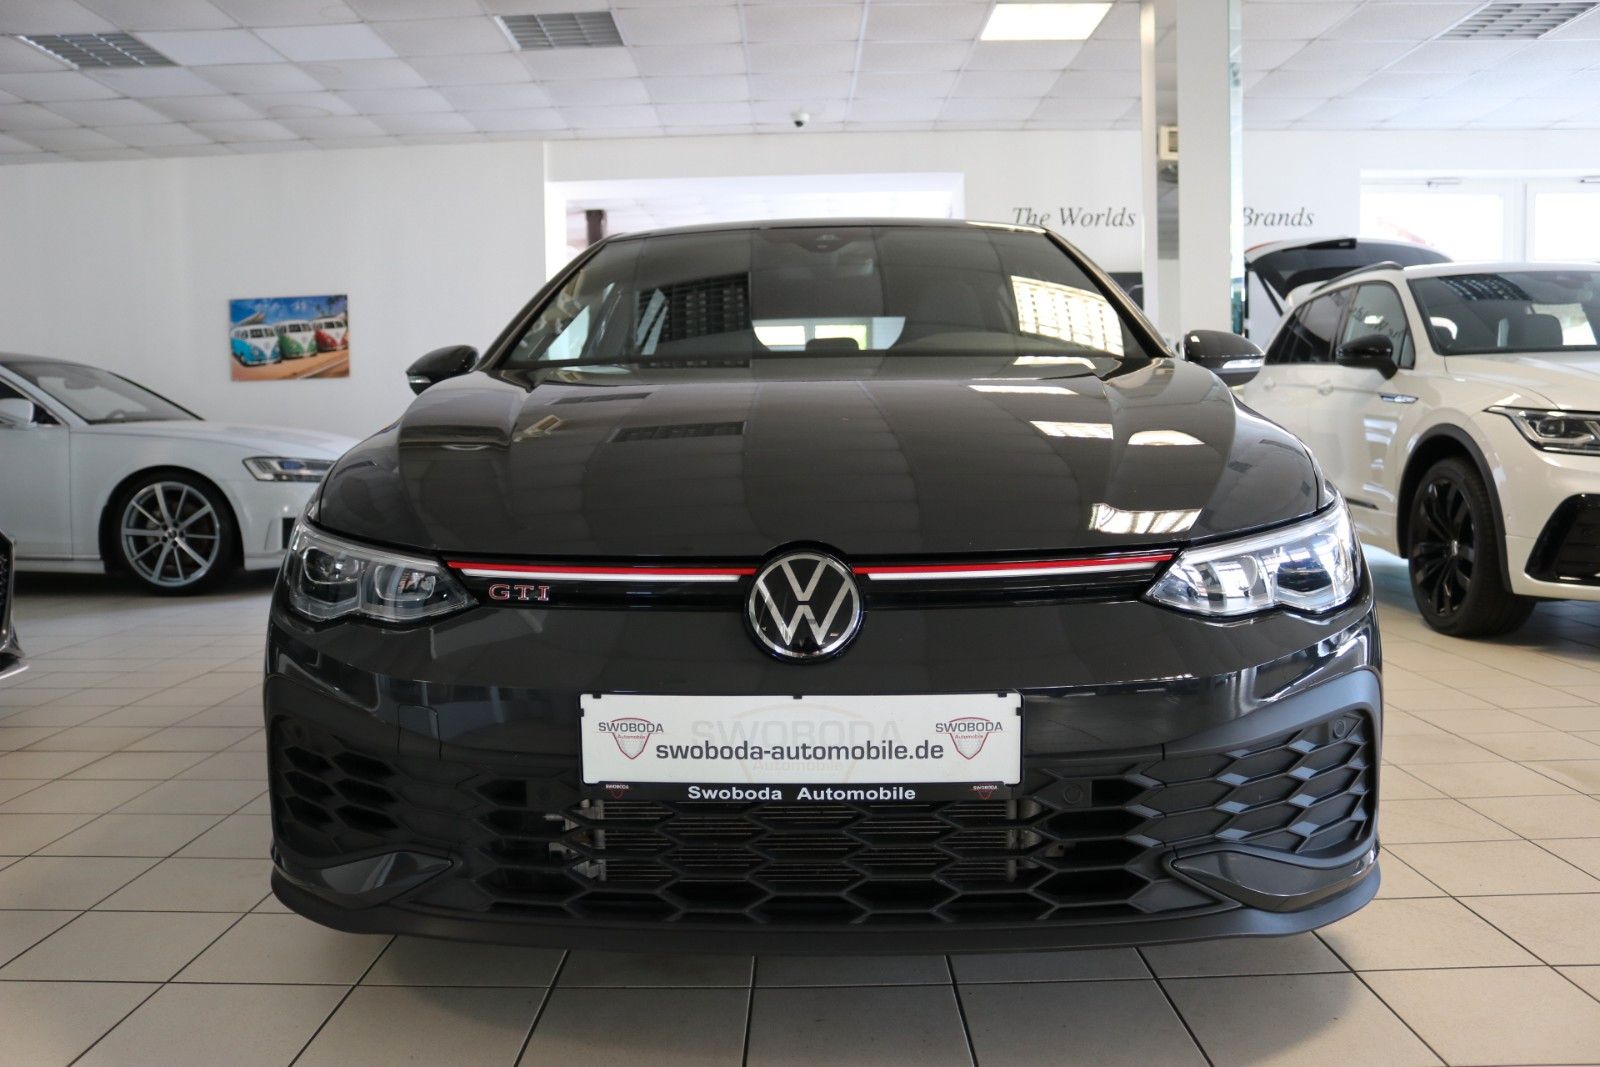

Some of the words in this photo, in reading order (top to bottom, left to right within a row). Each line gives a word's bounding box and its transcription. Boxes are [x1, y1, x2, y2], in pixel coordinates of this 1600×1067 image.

[1012, 206, 1051, 226] The
[1059, 206, 1137, 228] Worlds
[1243, 206, 1315, 227] Brands
[488, 583, 551, 601] GTI
[598, 722, 664, 733] SWOBODA
[935, 721, 1004, 733] SWOBODA
[656, 740, 944, 760] swoboda-automobile.de
[687, 785, 782, 801] Swoboda
[796, 786, 916, 801] Automobile
